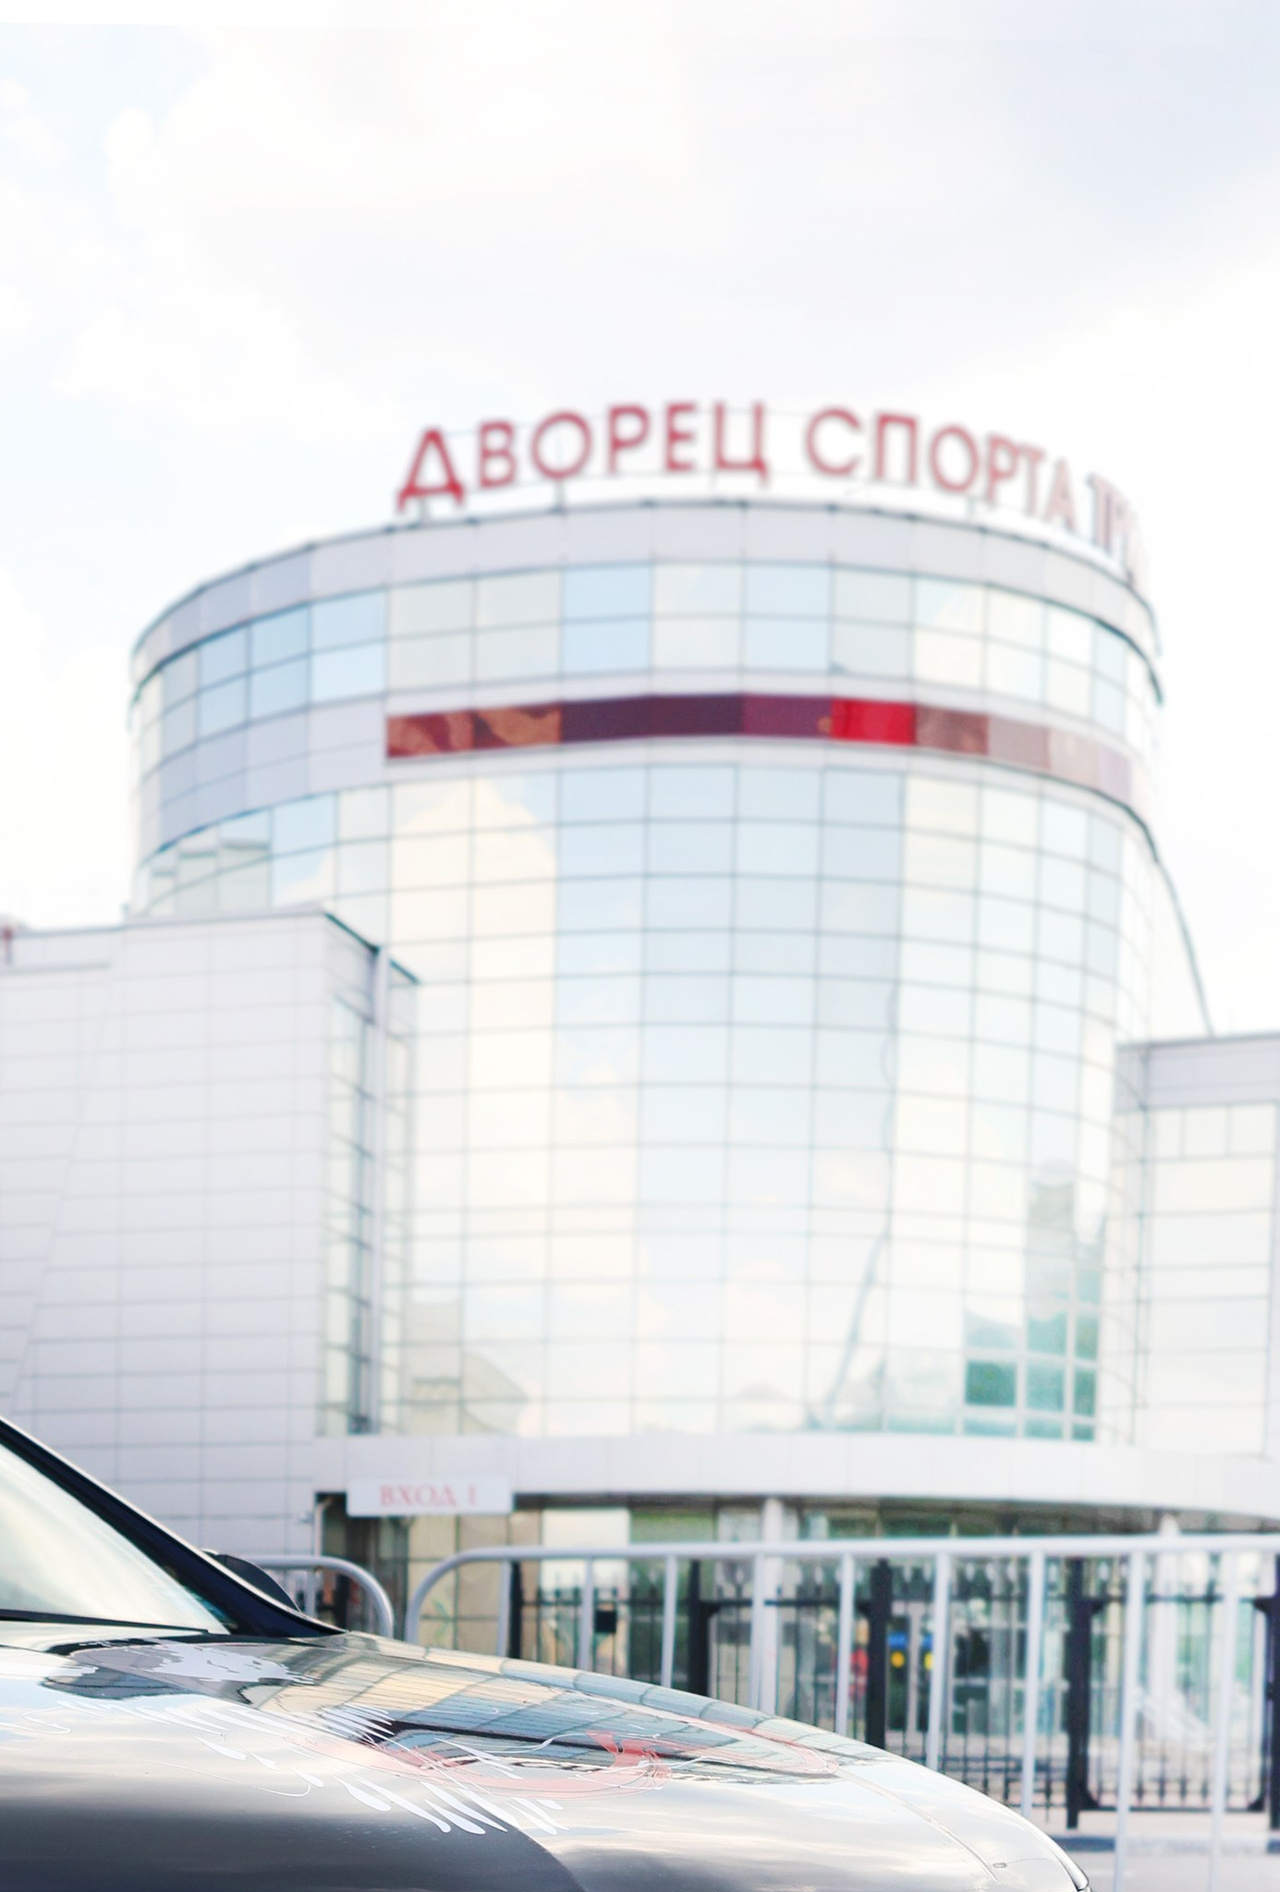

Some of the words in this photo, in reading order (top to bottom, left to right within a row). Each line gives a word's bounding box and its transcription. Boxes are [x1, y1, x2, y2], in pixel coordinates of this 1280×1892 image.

[395, 400, 768, 514] ДВОРЕЦ
[806, 407, 1077, 533] СПОРТА
[380, 1484, 458, 1508] ВХОД
